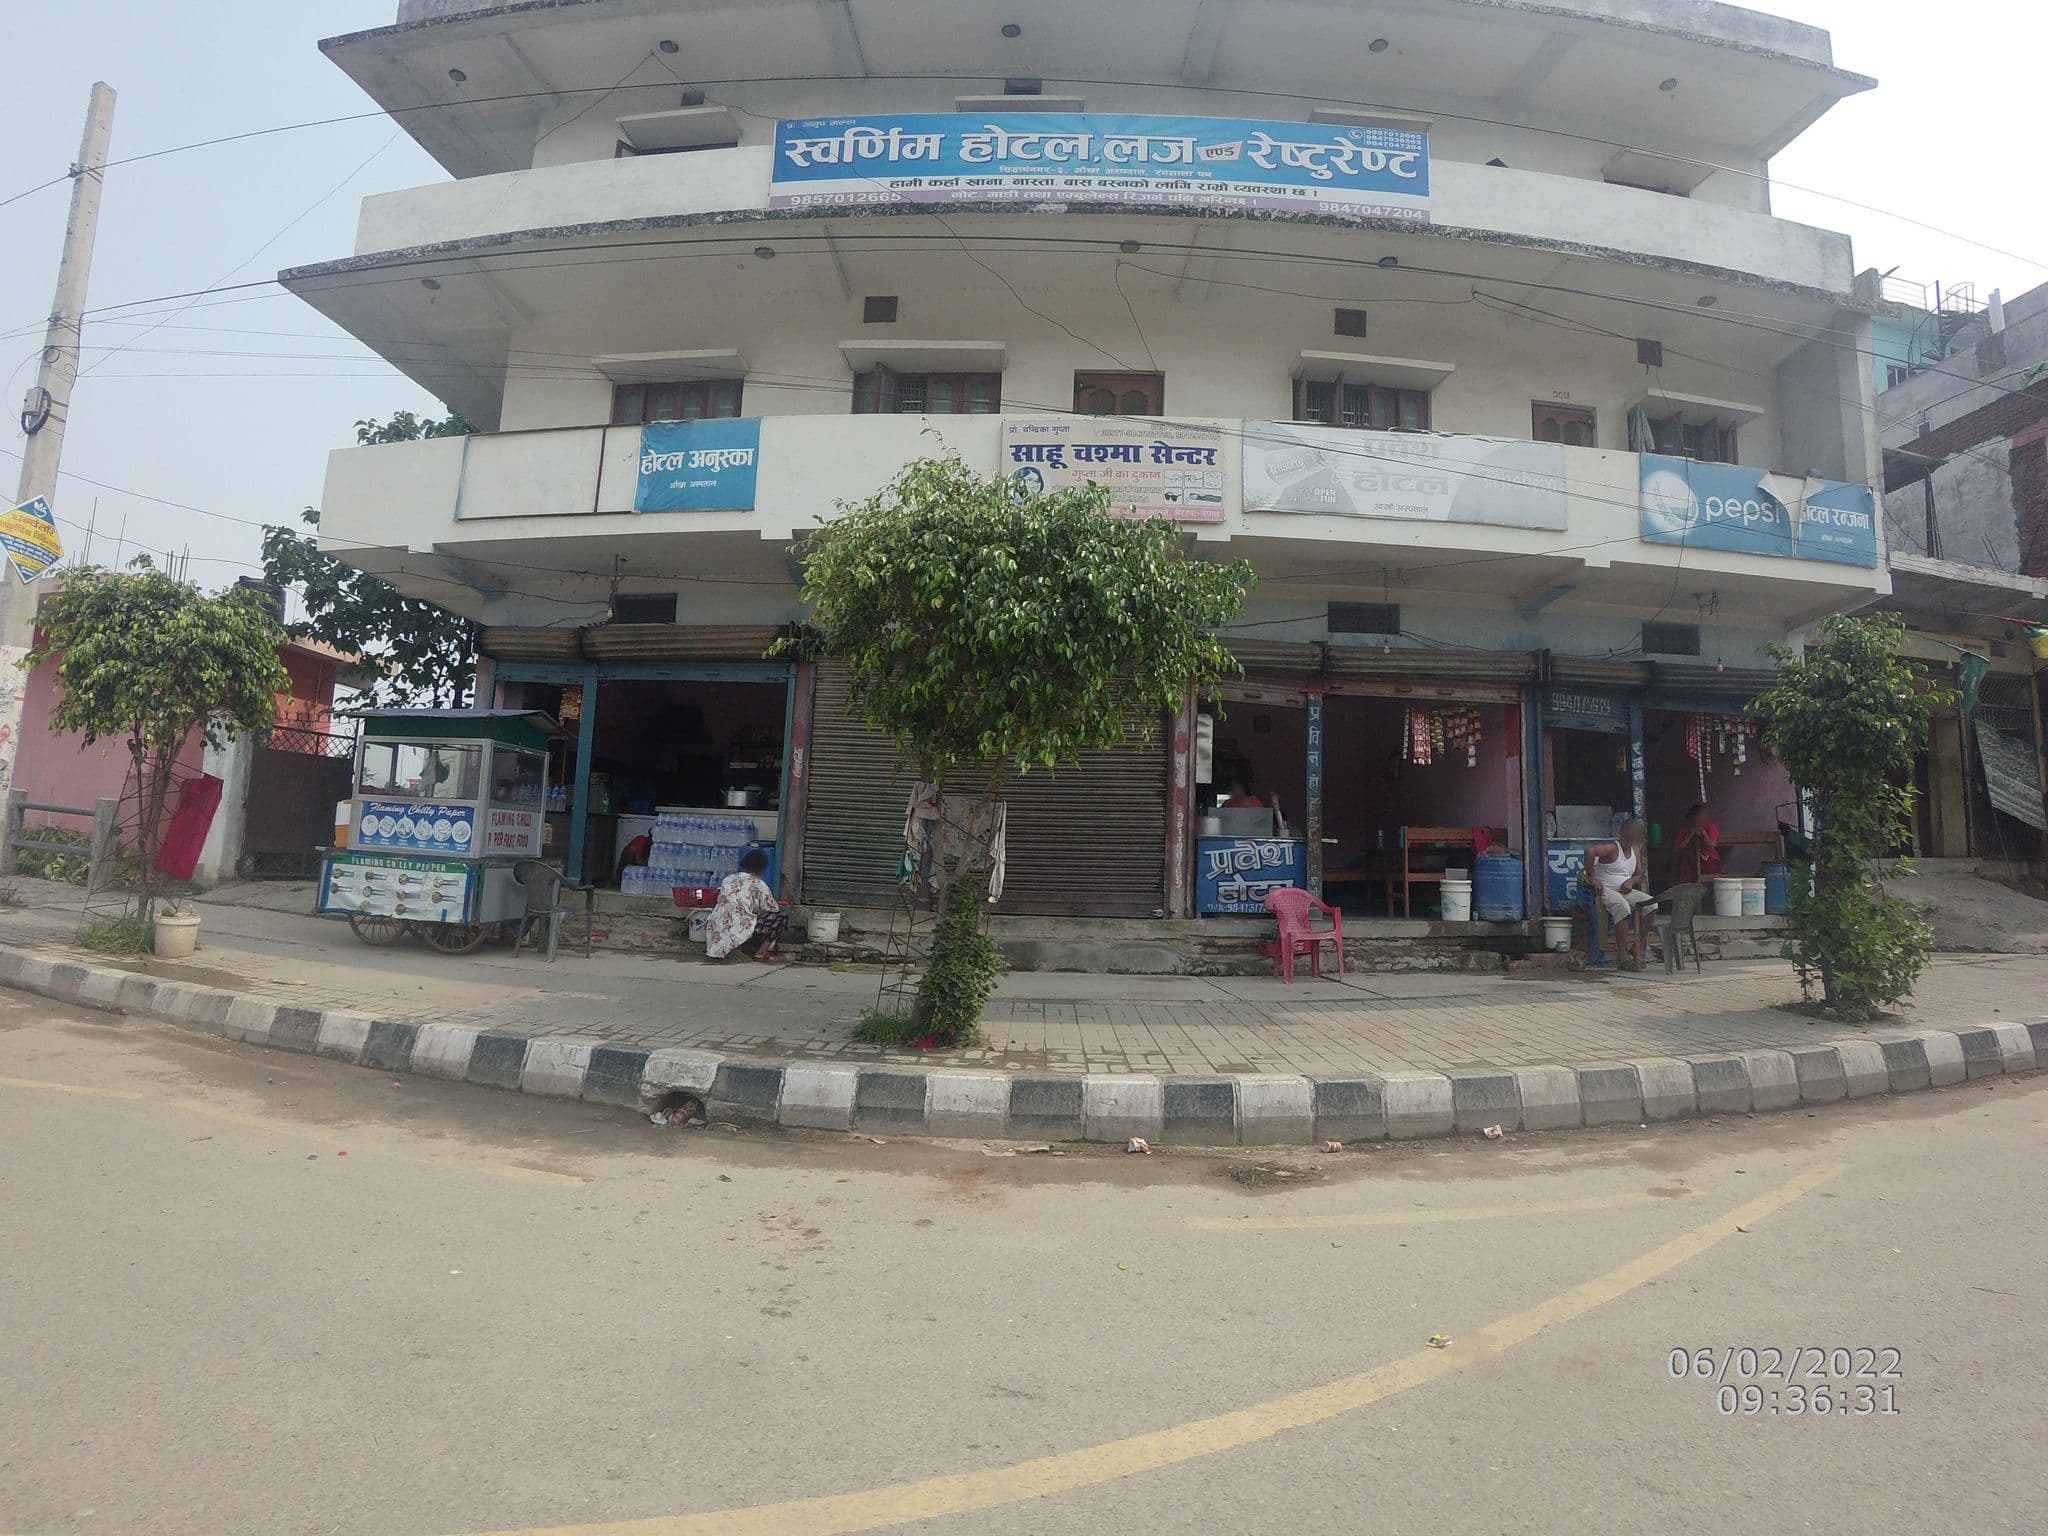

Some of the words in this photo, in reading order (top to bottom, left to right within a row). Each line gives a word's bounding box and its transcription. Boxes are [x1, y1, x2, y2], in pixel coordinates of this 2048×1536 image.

[784, 126, 946, 168] स्वर्णिम
[1102, 134, 1198, 164] लज
[1205, 146, 1236, 159] एण्ड
[790, 192, 900, 205] 9857012665
[1319, 202, 1423, 220] 9847047204
[640, 448, 686, 475] होटल
[1009, 443, 1068, 470] साहू
[1071, 443, 1144, 464] चश्मा
[1149, 440, 1218, 466] सेन्टर
[1100, 467, 1113, 479] जी
[1116, 469, 1129, 479] का
[1705, 496, 1782, 526] pepsi
[408, 804, 436, 817] Chilly
[351, 856, 383, 866] FLAMING
[1204, 840, 1295, 880] प्रवेश
